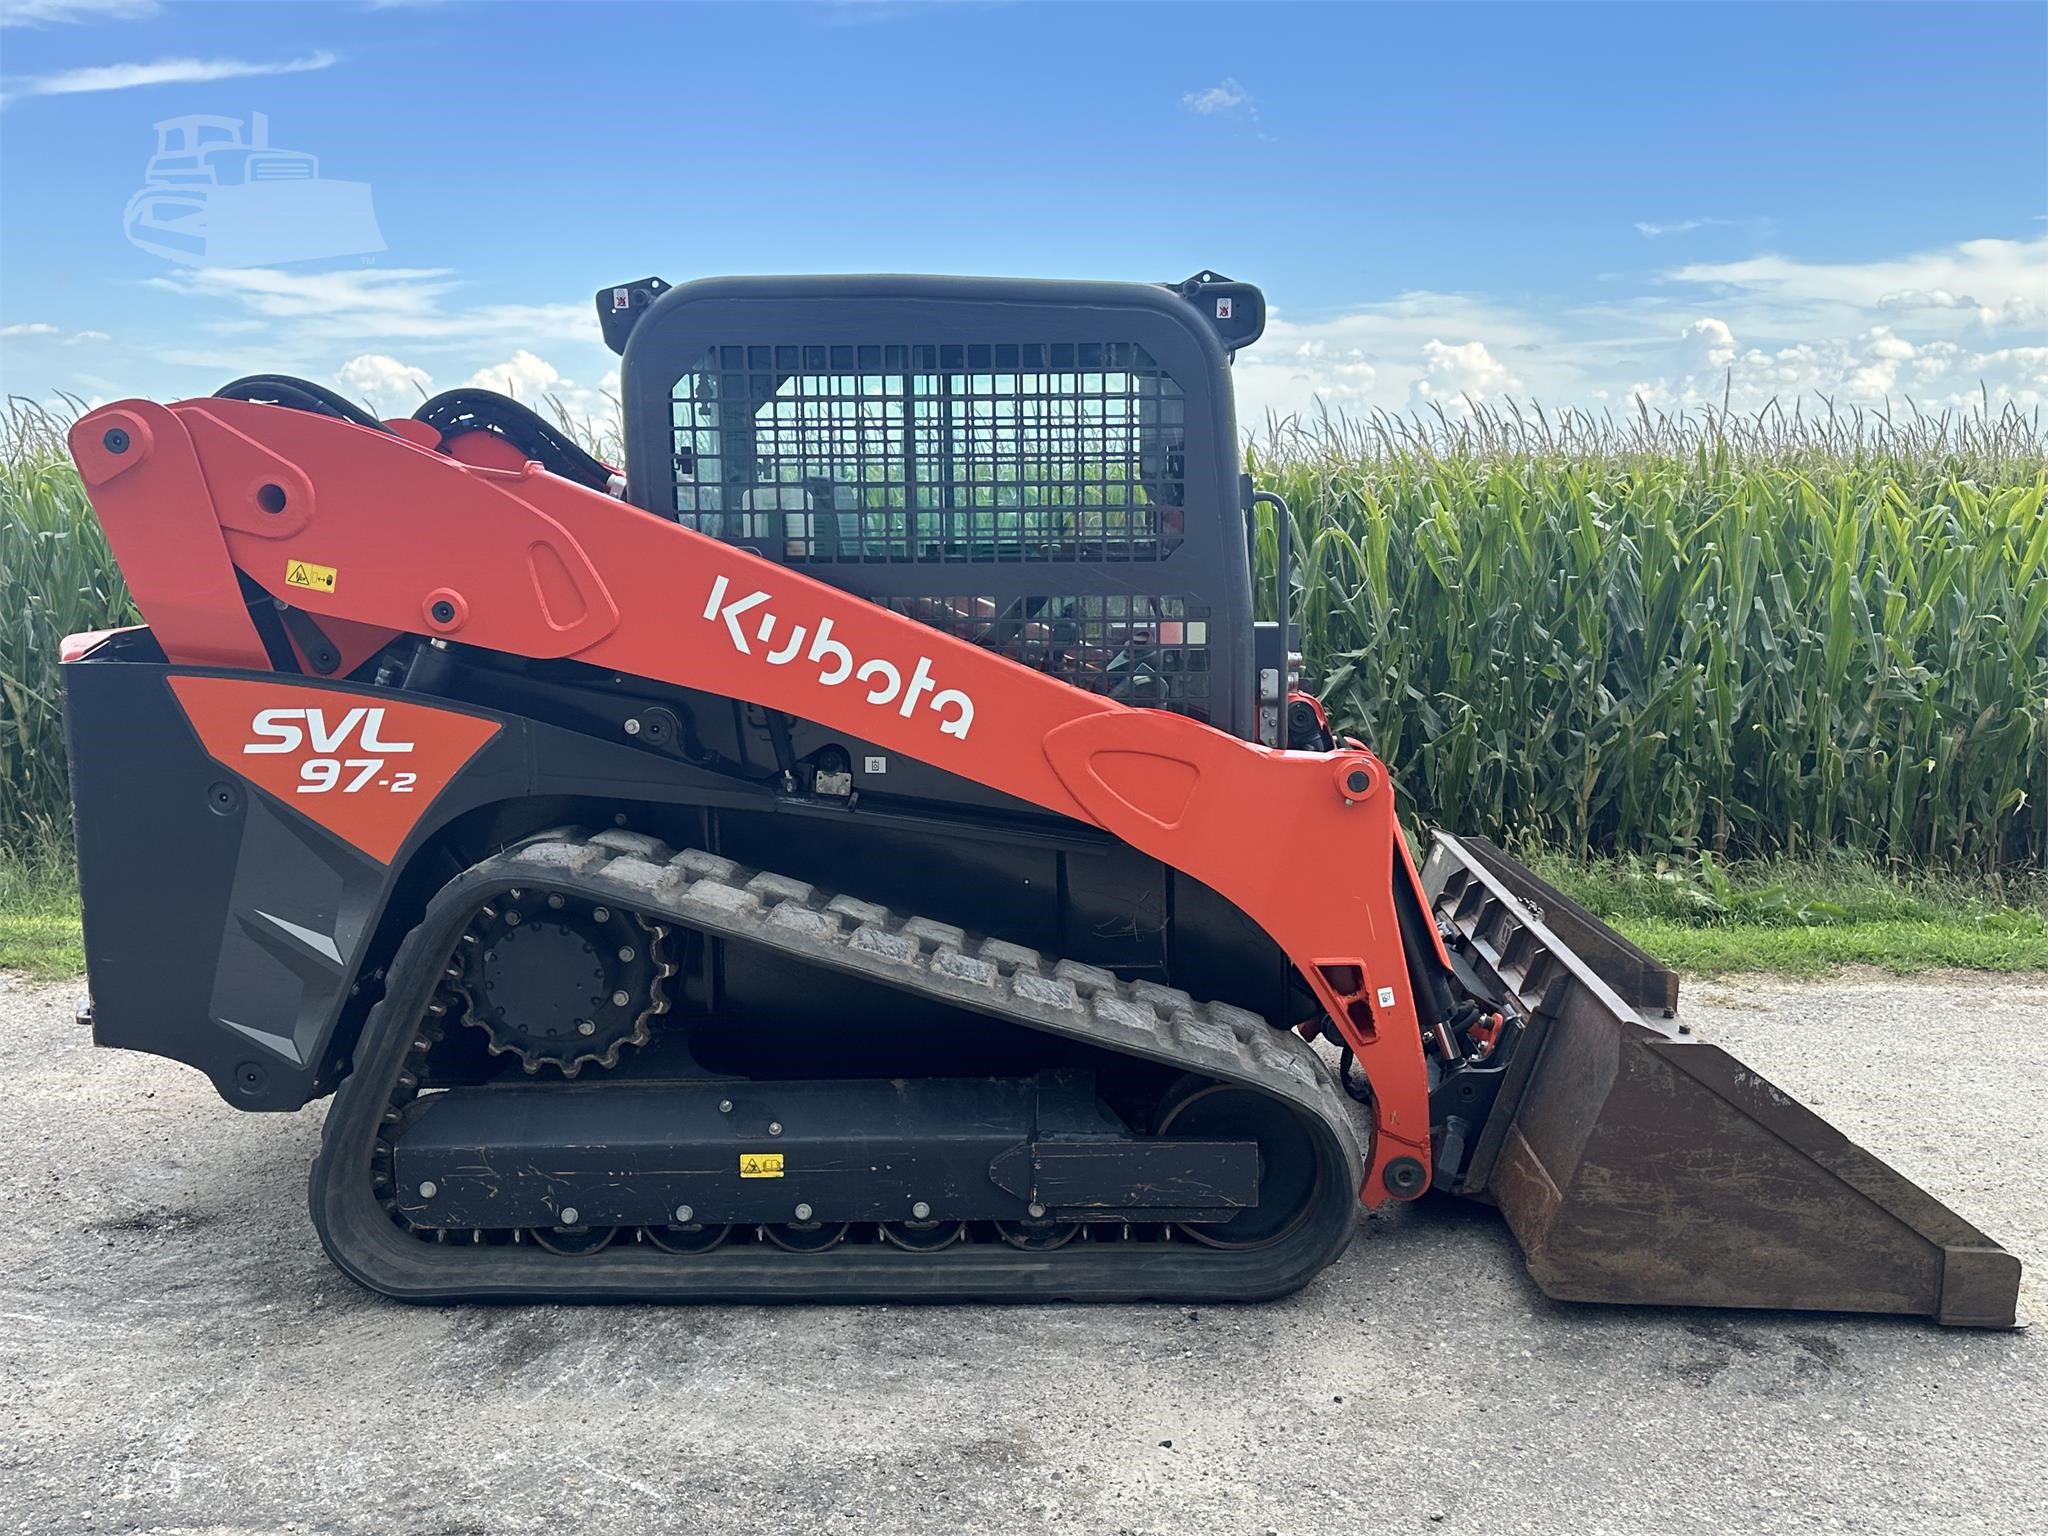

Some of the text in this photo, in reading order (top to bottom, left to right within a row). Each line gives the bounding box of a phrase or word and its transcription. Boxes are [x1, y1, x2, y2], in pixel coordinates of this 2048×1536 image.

[704, 575, 975, 741] Kubota
[243, 707, 415, 754] SVL
[296, 758, 417, 793] 97-2
